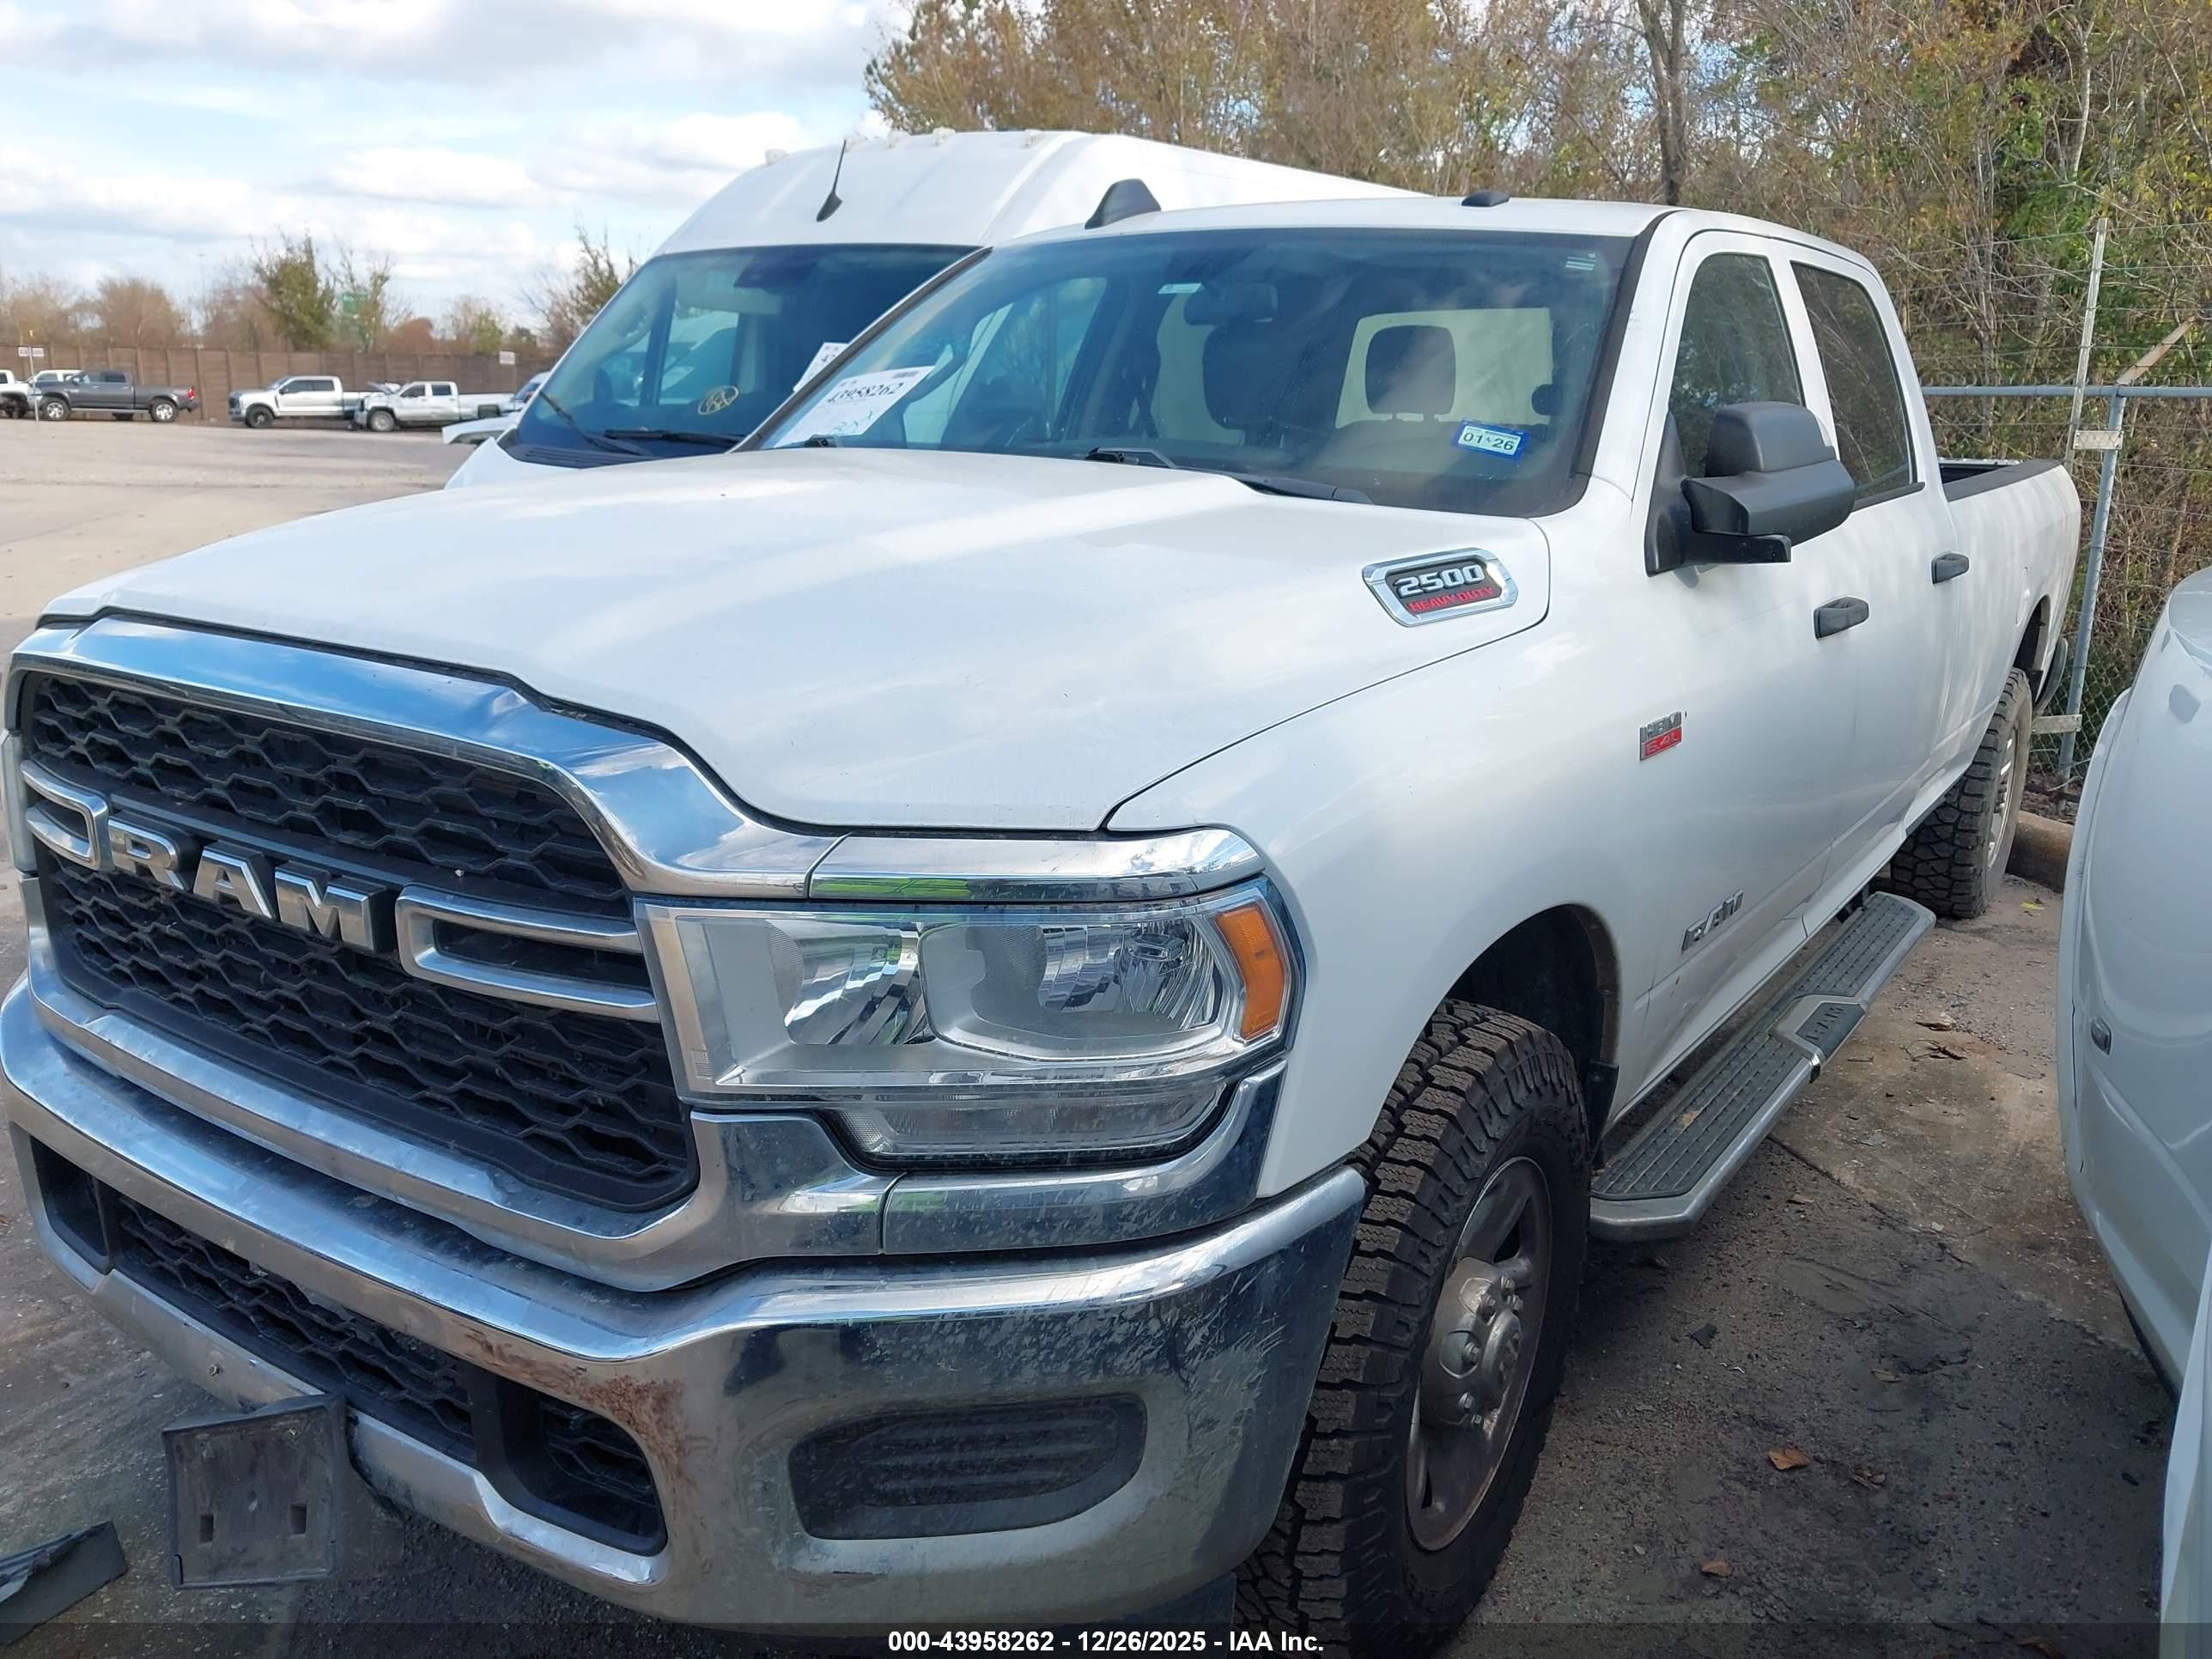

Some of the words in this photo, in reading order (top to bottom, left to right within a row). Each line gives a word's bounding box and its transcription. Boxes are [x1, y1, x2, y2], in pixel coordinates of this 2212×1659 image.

[1394, 564, 1485, 597] 2500
[1408, 592, 1457, 612] HEAVY
[1458, 586, 1495, 603] DUTY
[108, 817, 376, 951] RAM
[1681, 890, 1744, 953] RAM
